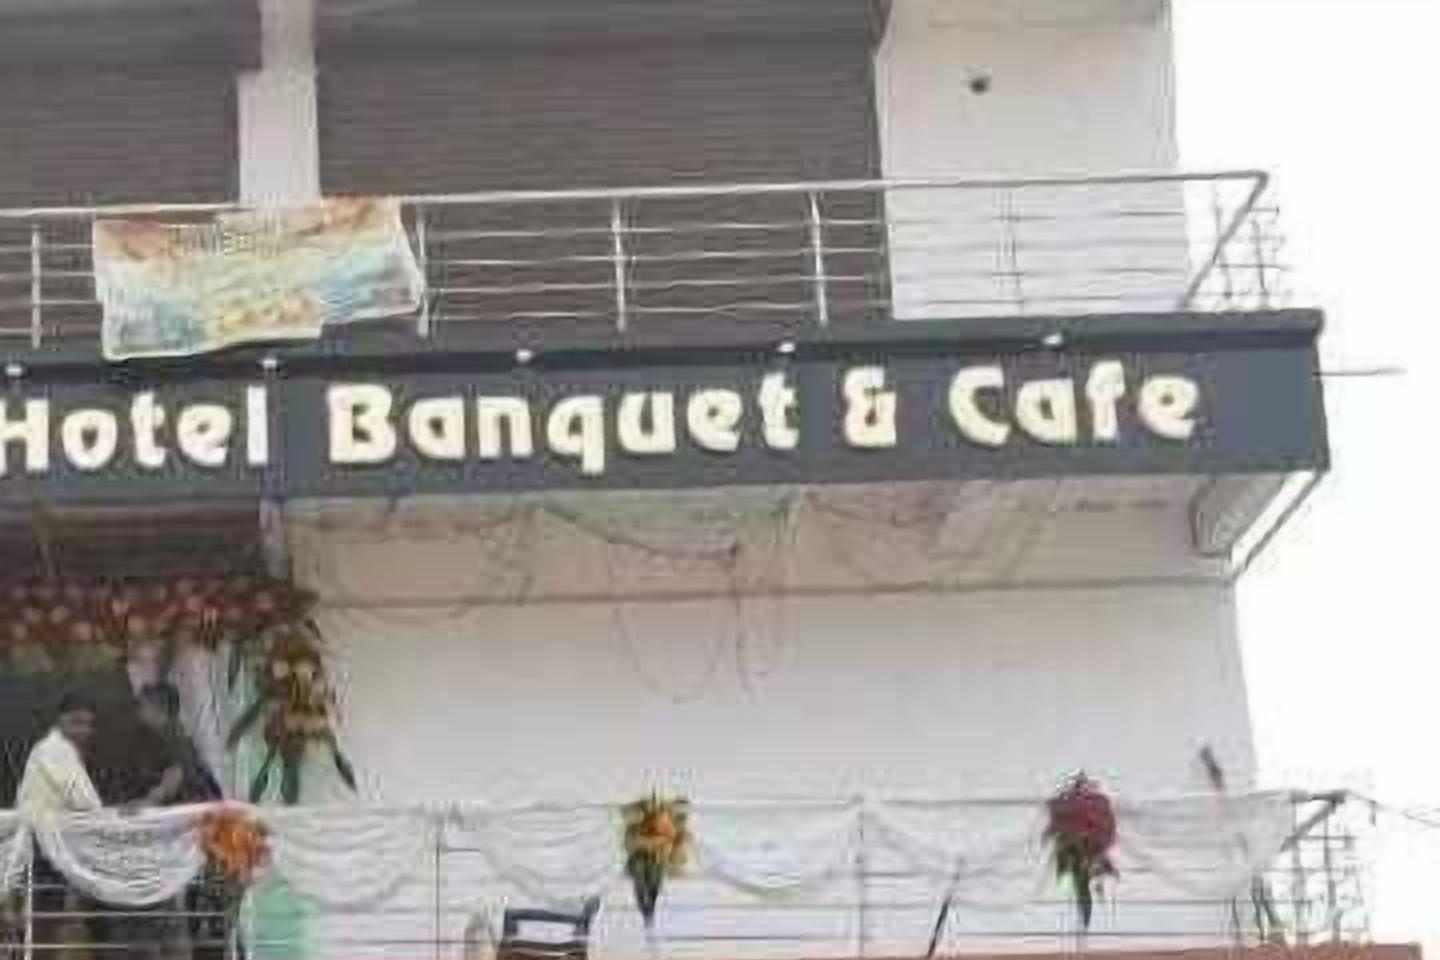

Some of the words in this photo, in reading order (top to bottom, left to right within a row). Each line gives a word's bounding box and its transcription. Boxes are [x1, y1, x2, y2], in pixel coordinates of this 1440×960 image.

[326, 372, 801, 474] Banquet
[842, 367, 898, 449] &
[950, 360, 1201, 446] Cafe
